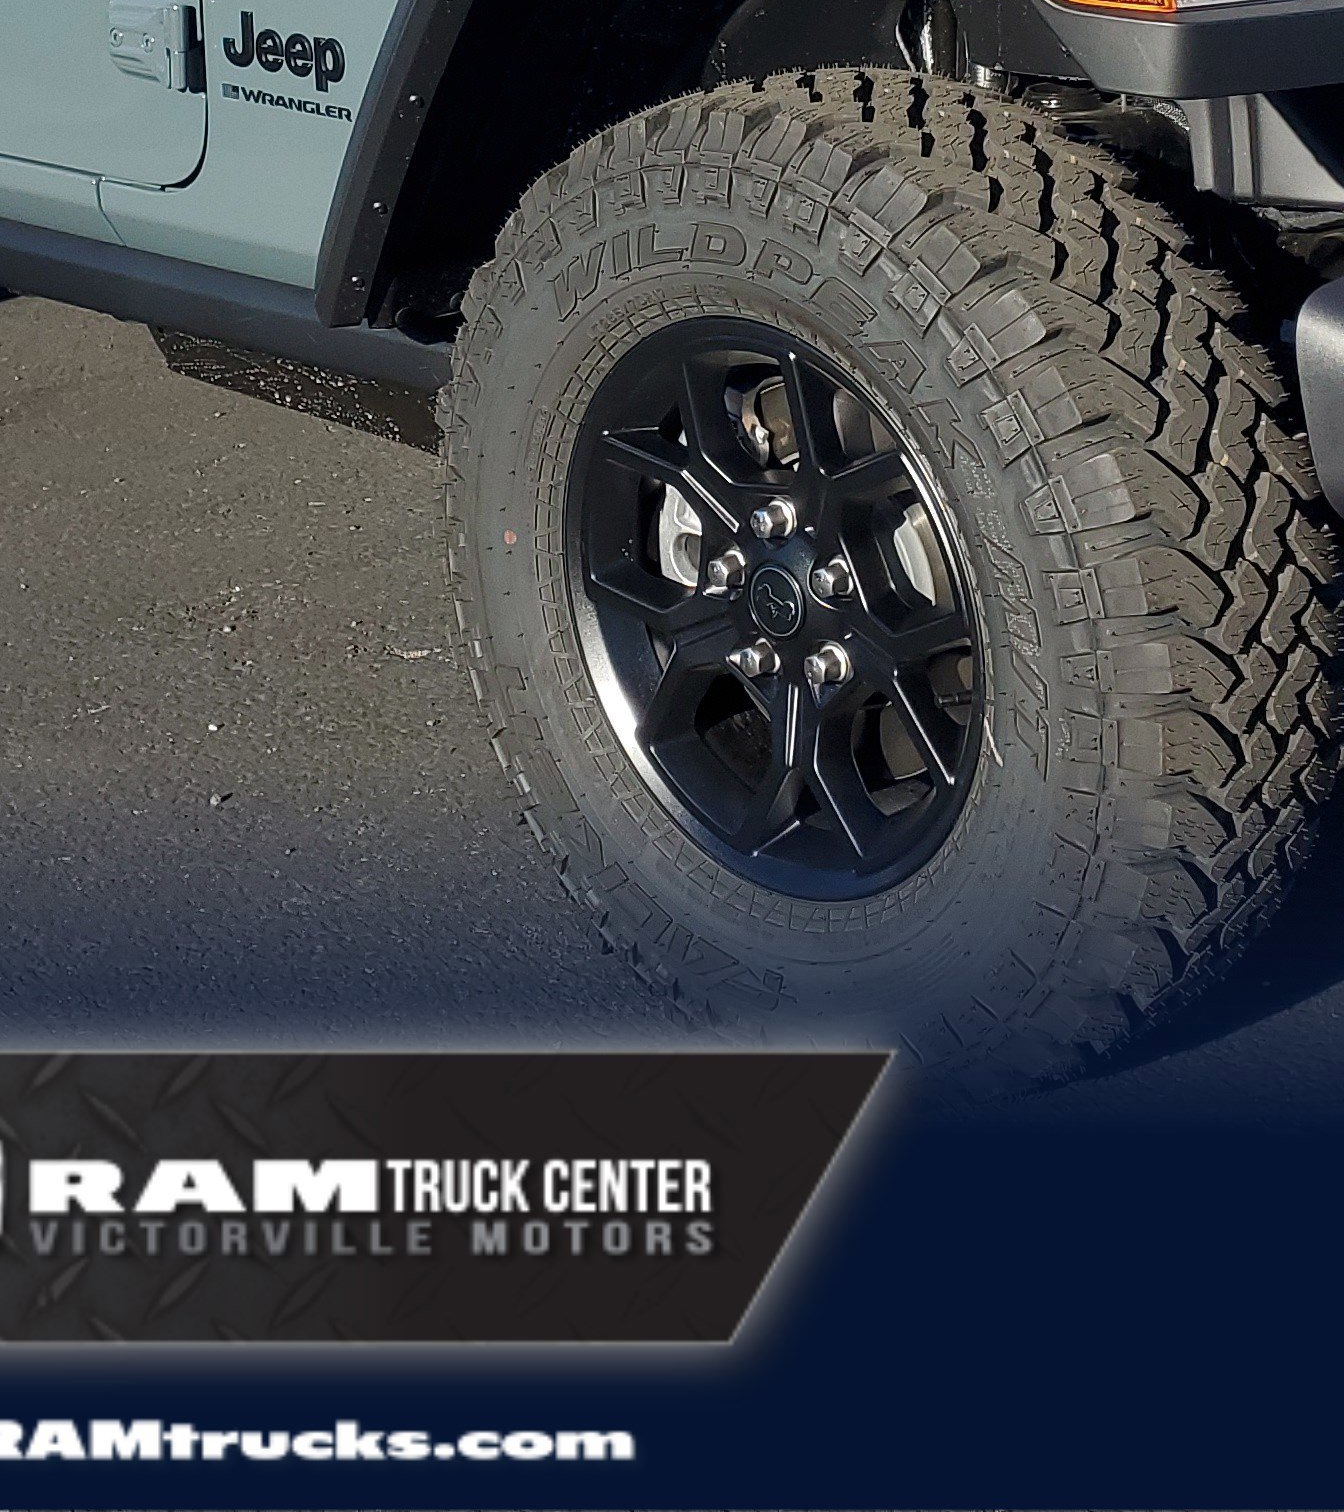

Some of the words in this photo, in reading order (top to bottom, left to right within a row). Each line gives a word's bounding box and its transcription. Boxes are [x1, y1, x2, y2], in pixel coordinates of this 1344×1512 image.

[222, 10, 347, 94] Jeep
[240, 86, 353, 123] WRANGLER
[553, 220, 984, 469] WILDPEAK
